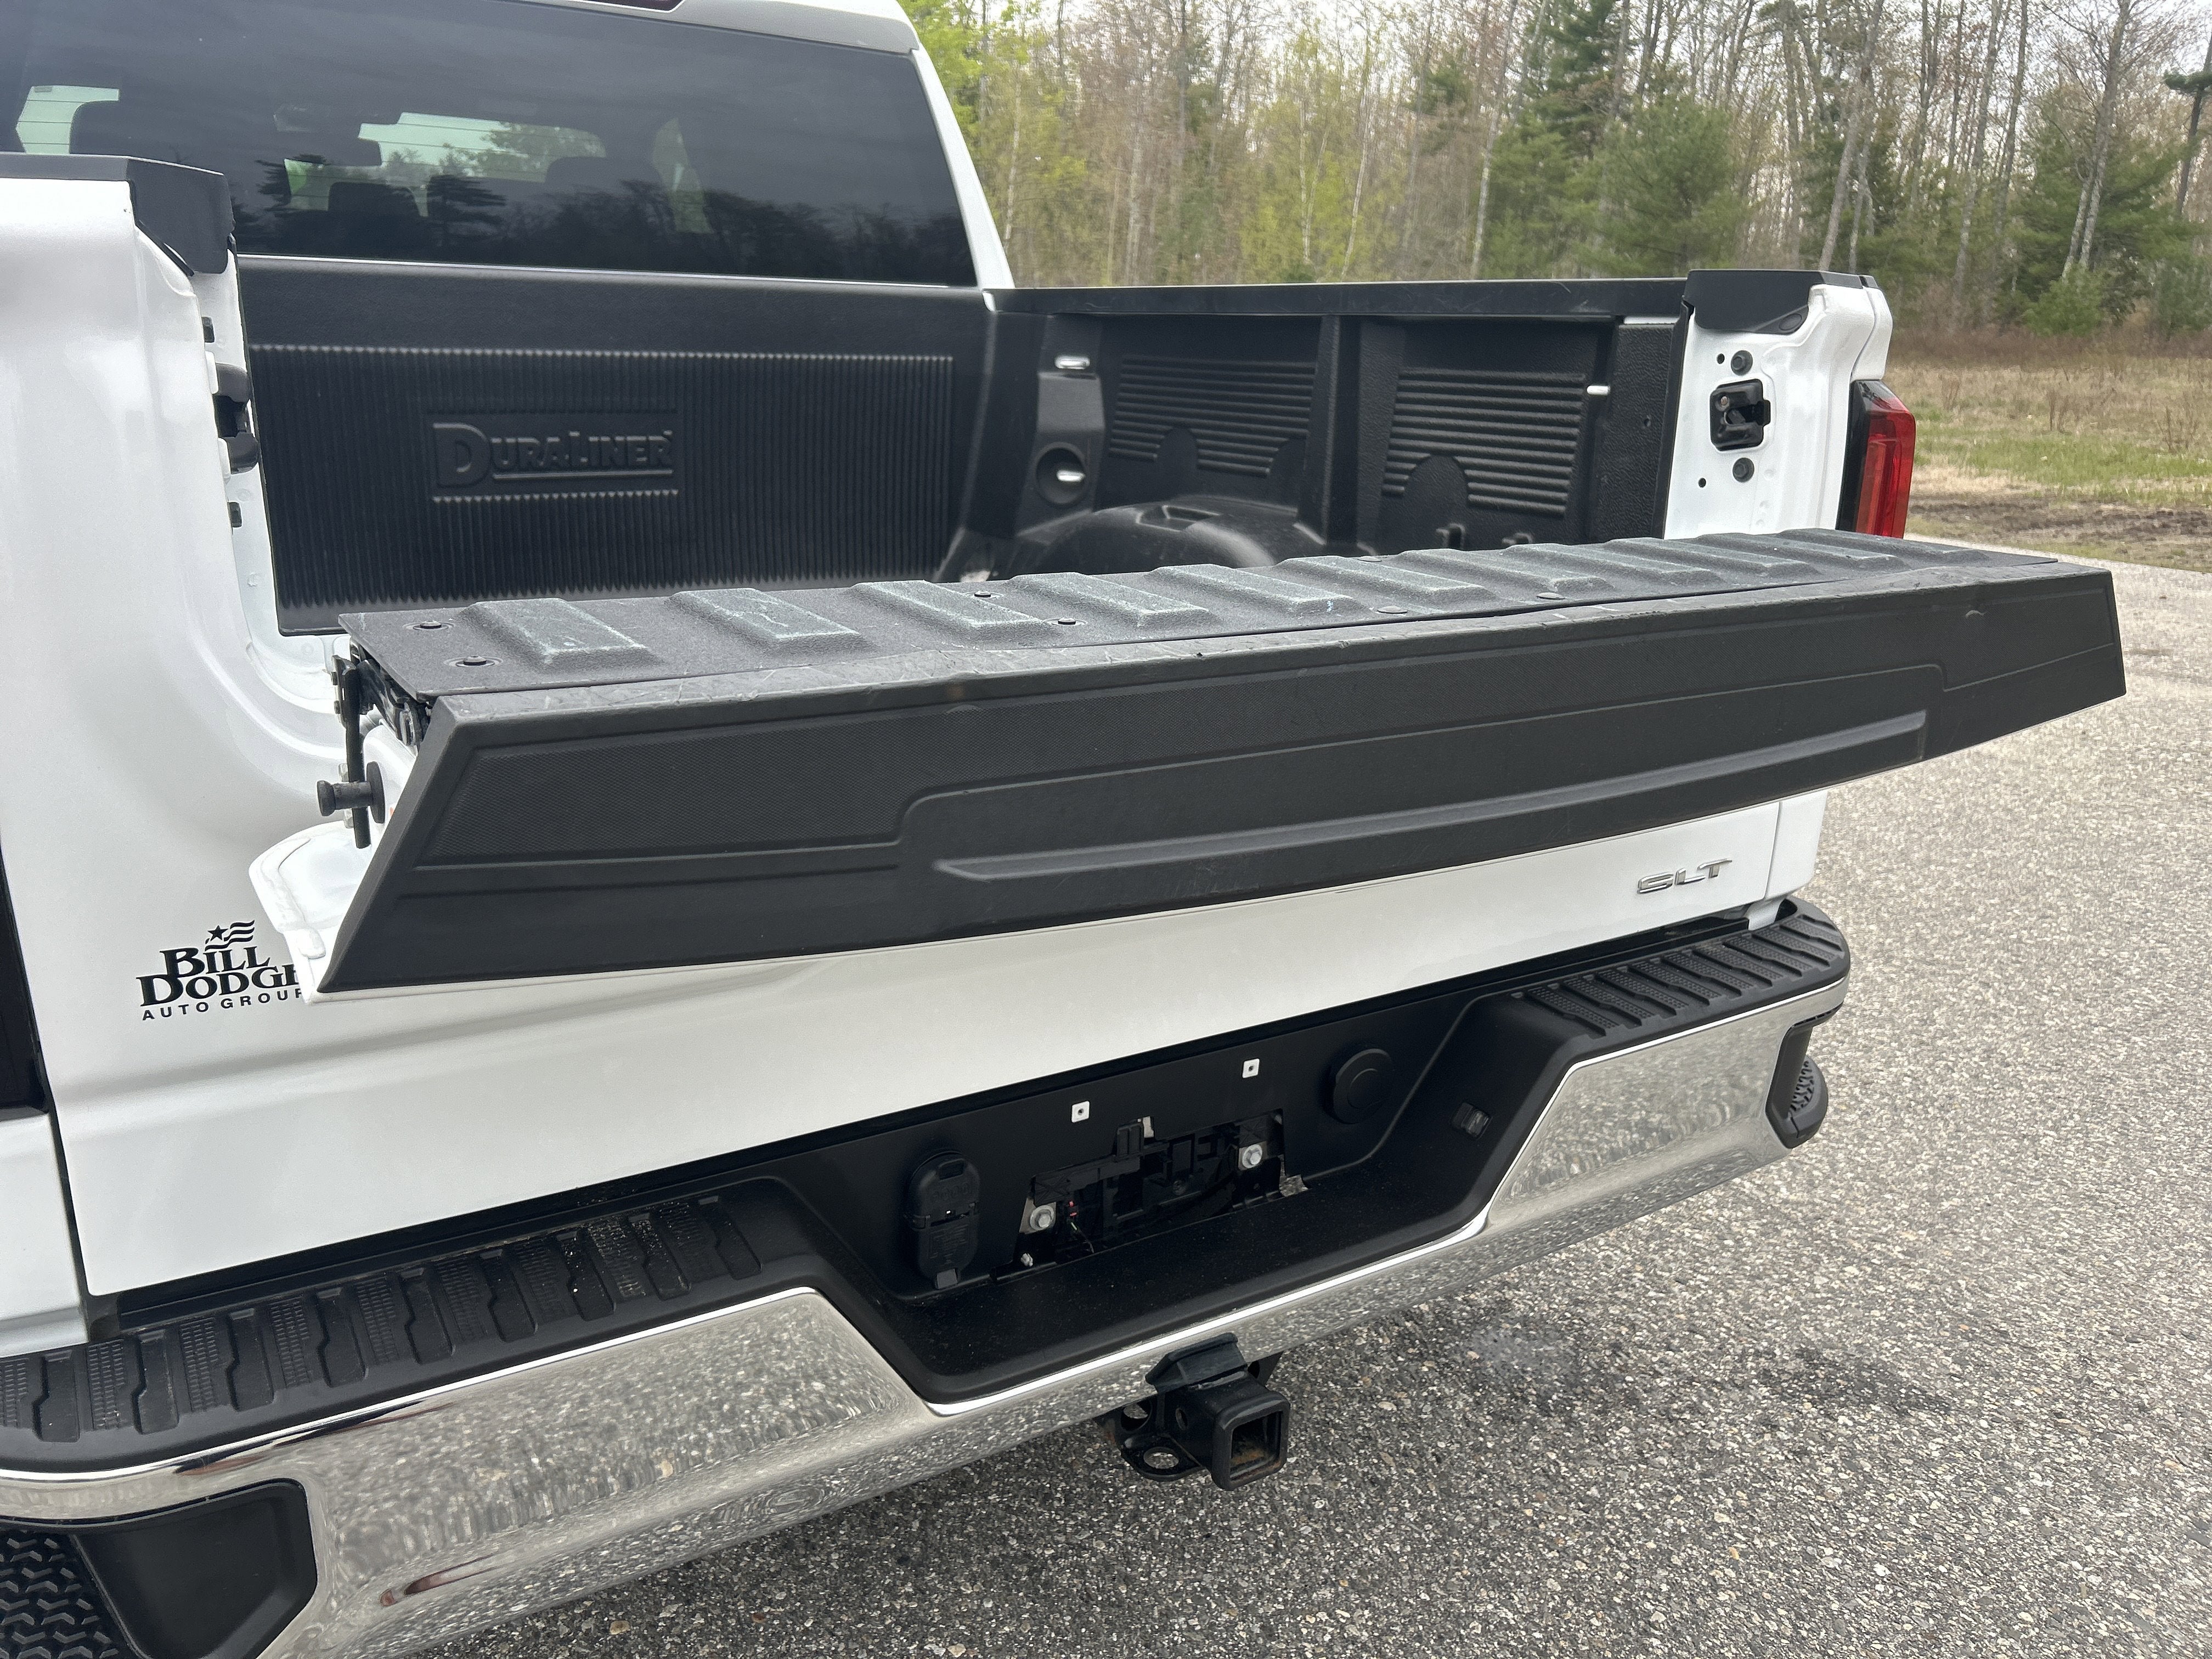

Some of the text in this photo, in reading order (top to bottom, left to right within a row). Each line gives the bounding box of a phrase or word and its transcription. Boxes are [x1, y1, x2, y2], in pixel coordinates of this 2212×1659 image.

[433, 421, 673, 488] DURALINER
[1637, 858, 1733, 894] SLT
[160, 946, 270, 978] BILL
[142, 1002, 209, 1020] AUTO
